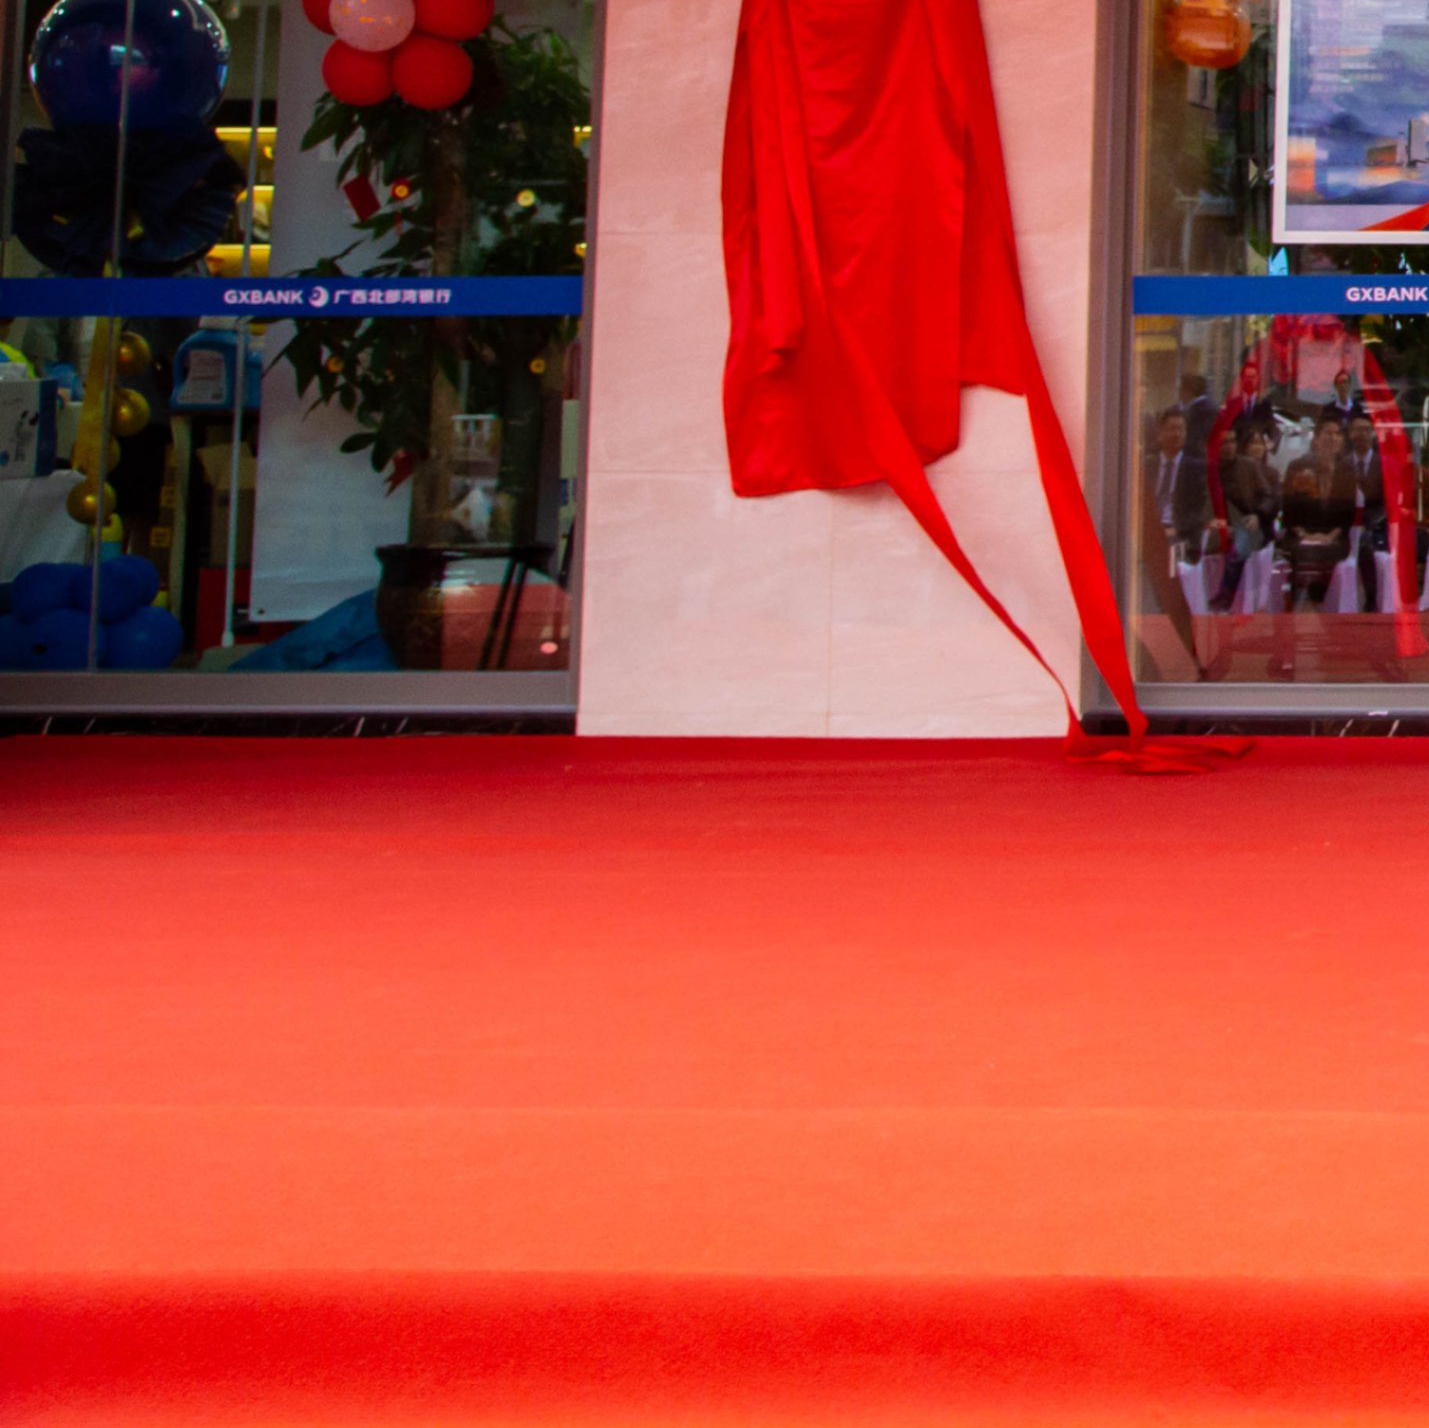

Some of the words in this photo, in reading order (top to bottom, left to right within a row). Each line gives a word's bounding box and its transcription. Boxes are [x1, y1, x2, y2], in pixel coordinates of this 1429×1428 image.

[223, 289, 303, 305] GXBANK
[333, 289, 451, 305] 广西北部湾银行
[1345, 286, 1428, 303] GXBANK
